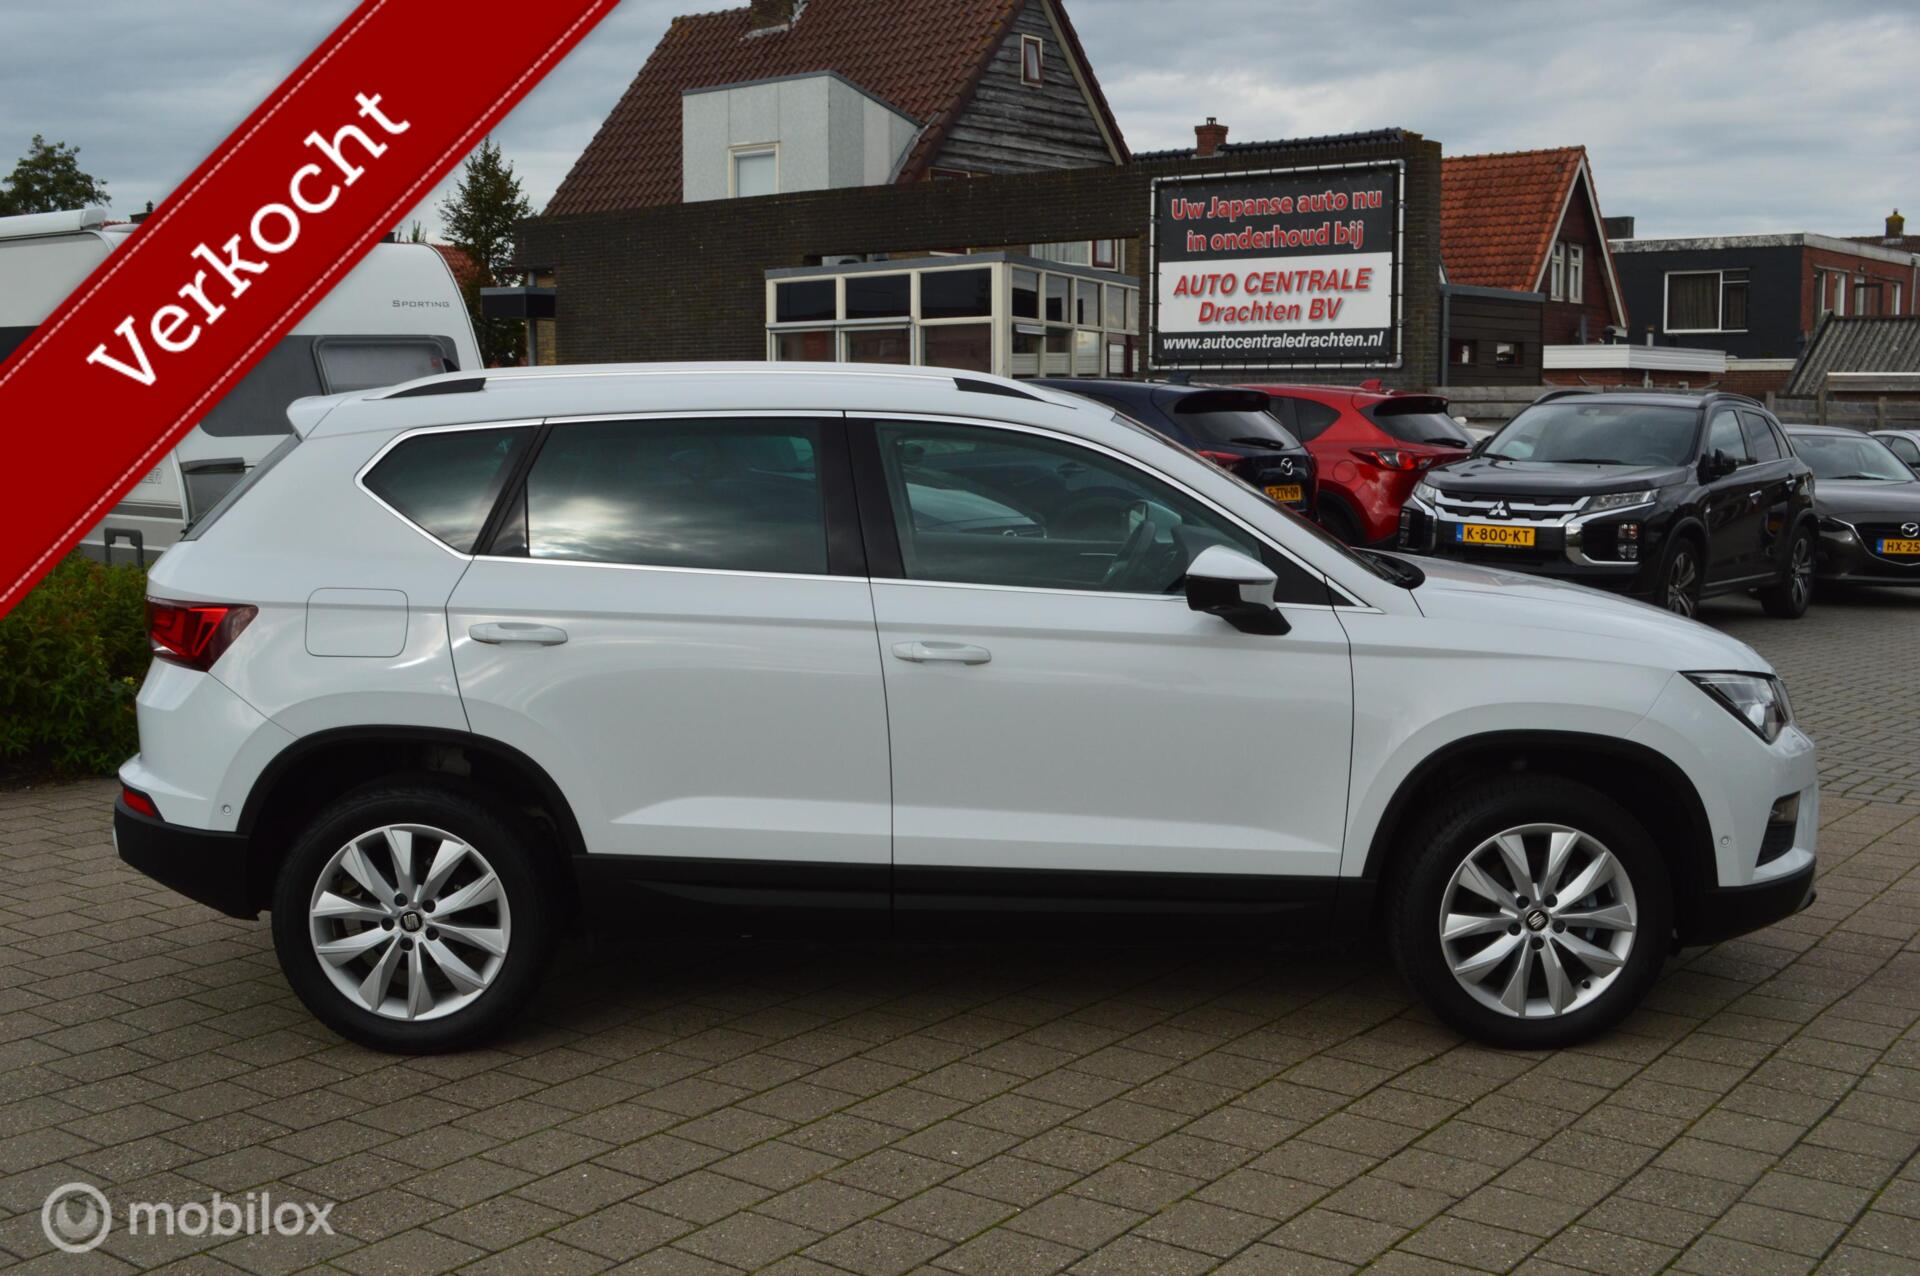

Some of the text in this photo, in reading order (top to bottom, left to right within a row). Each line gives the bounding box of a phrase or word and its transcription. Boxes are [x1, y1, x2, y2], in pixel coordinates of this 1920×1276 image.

[1171, 190, 1383, 222] Uw Japanse auto nu
[1187, 220, 1364, 252] in onderhoud bij
[1173, 268, 1372, 296] AUTO CENTRALE
[1198, 297, 1342, 323] Drachten BV
[1163, 331, 1384, 350] www.autocentraledrachten.nl
[1466, 527, 1531, 543] K-800-KT
